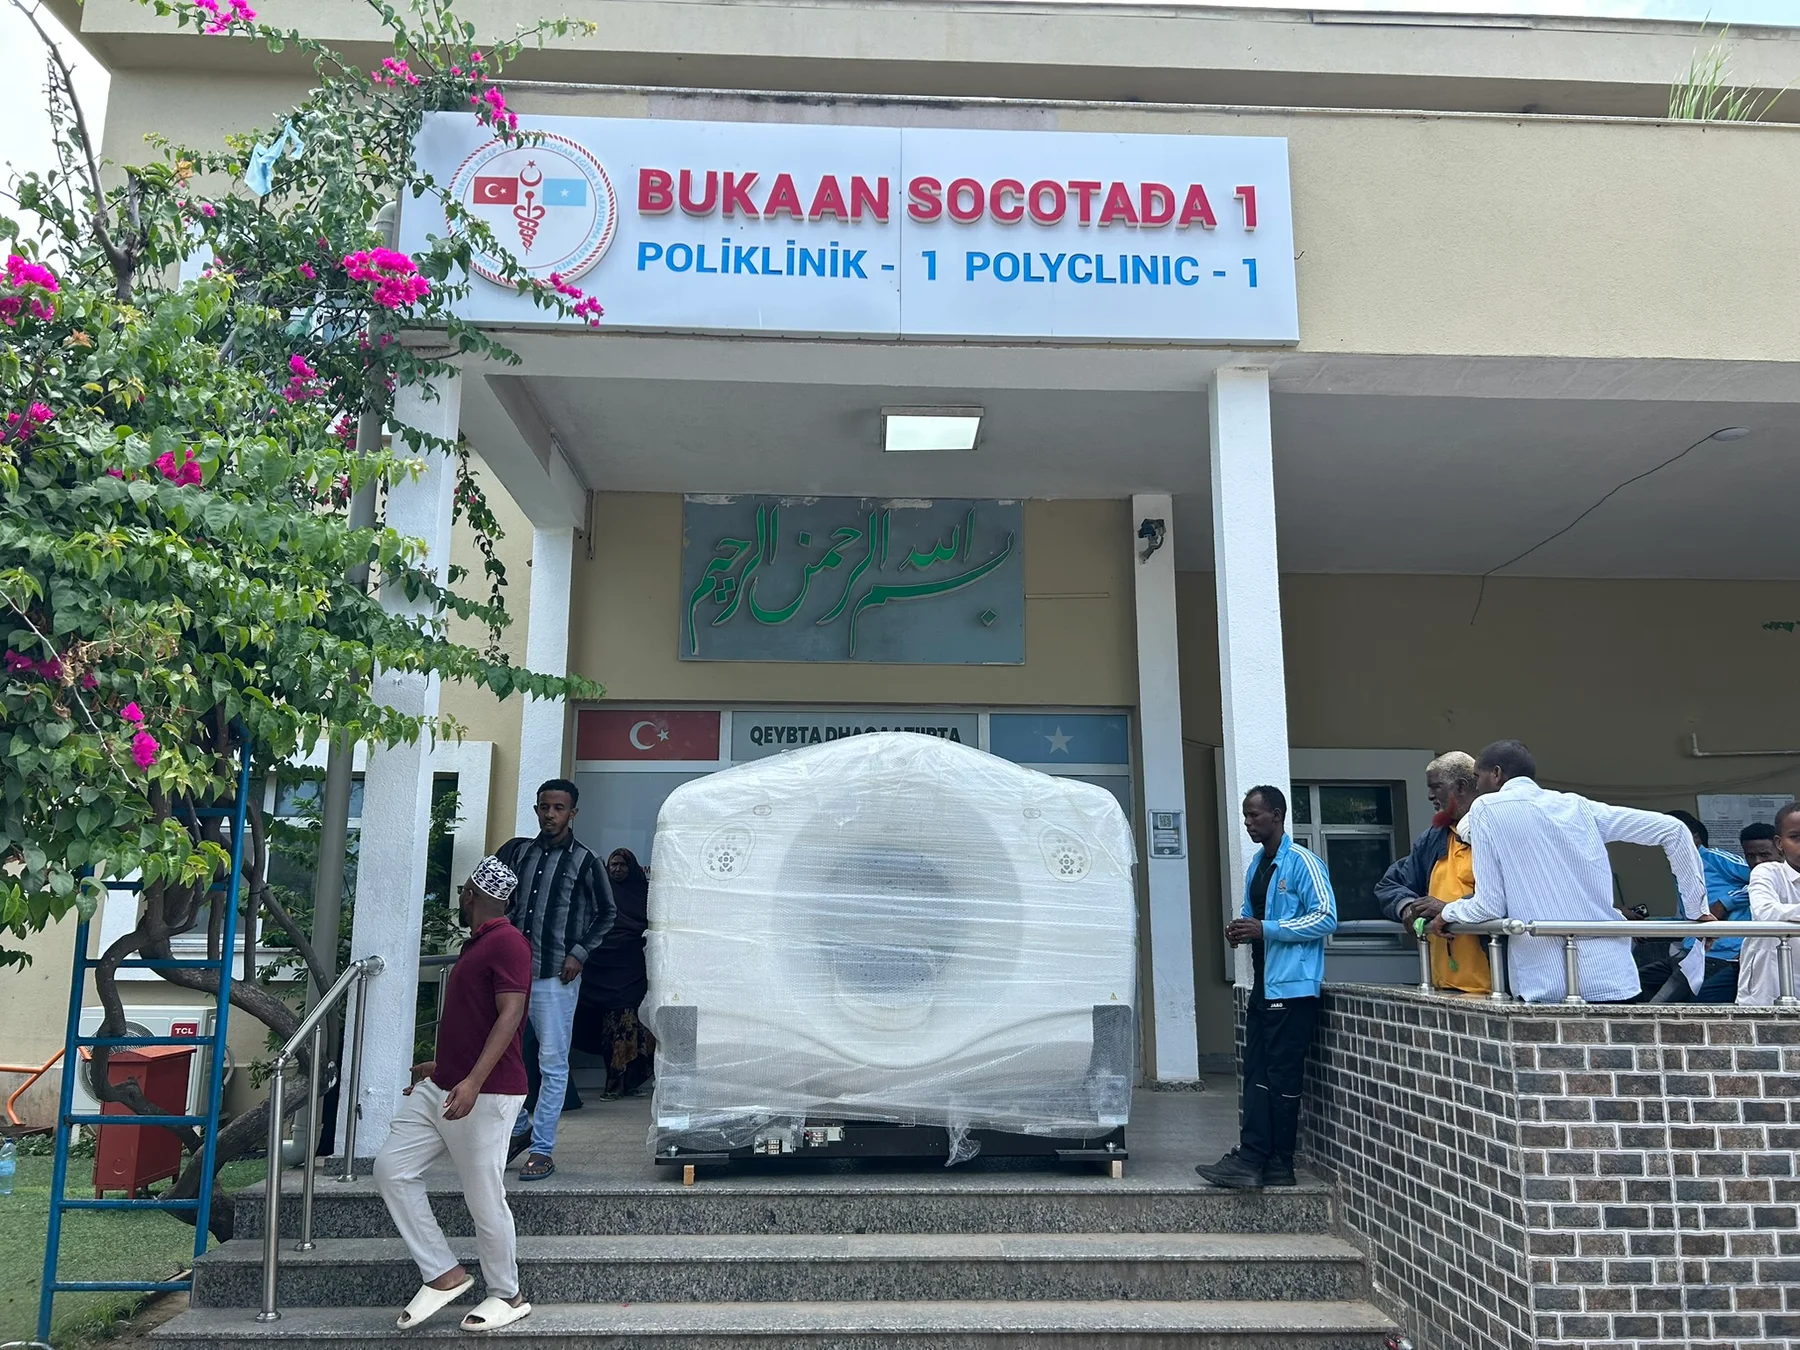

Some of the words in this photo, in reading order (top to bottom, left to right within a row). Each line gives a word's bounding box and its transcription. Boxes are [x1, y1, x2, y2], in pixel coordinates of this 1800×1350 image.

[474, 147, 498, 167] RECEP
[638, 168, 890, 223] BUKAAN
[907, 176, 1218, 229] SOCOTADA
[1234, 184, 1257, 231] 1
[637, 237, 868, 279] POLİKLİNİK
[922, 250, 937, 281] 1
[966, 251, 1200, 286] POLYCLINIC
[1243, 258, 1258, 288] 1
[749, 508, 892, 625] الرحمن
[899, 507, 976, 572] الله
[688, 503, 780, 656] الرحيم
[849, 529, 1015, 658] بسم
[750, 726, 821, 746] QEYBTA
[174, 1027, 194, 1035] TCL
